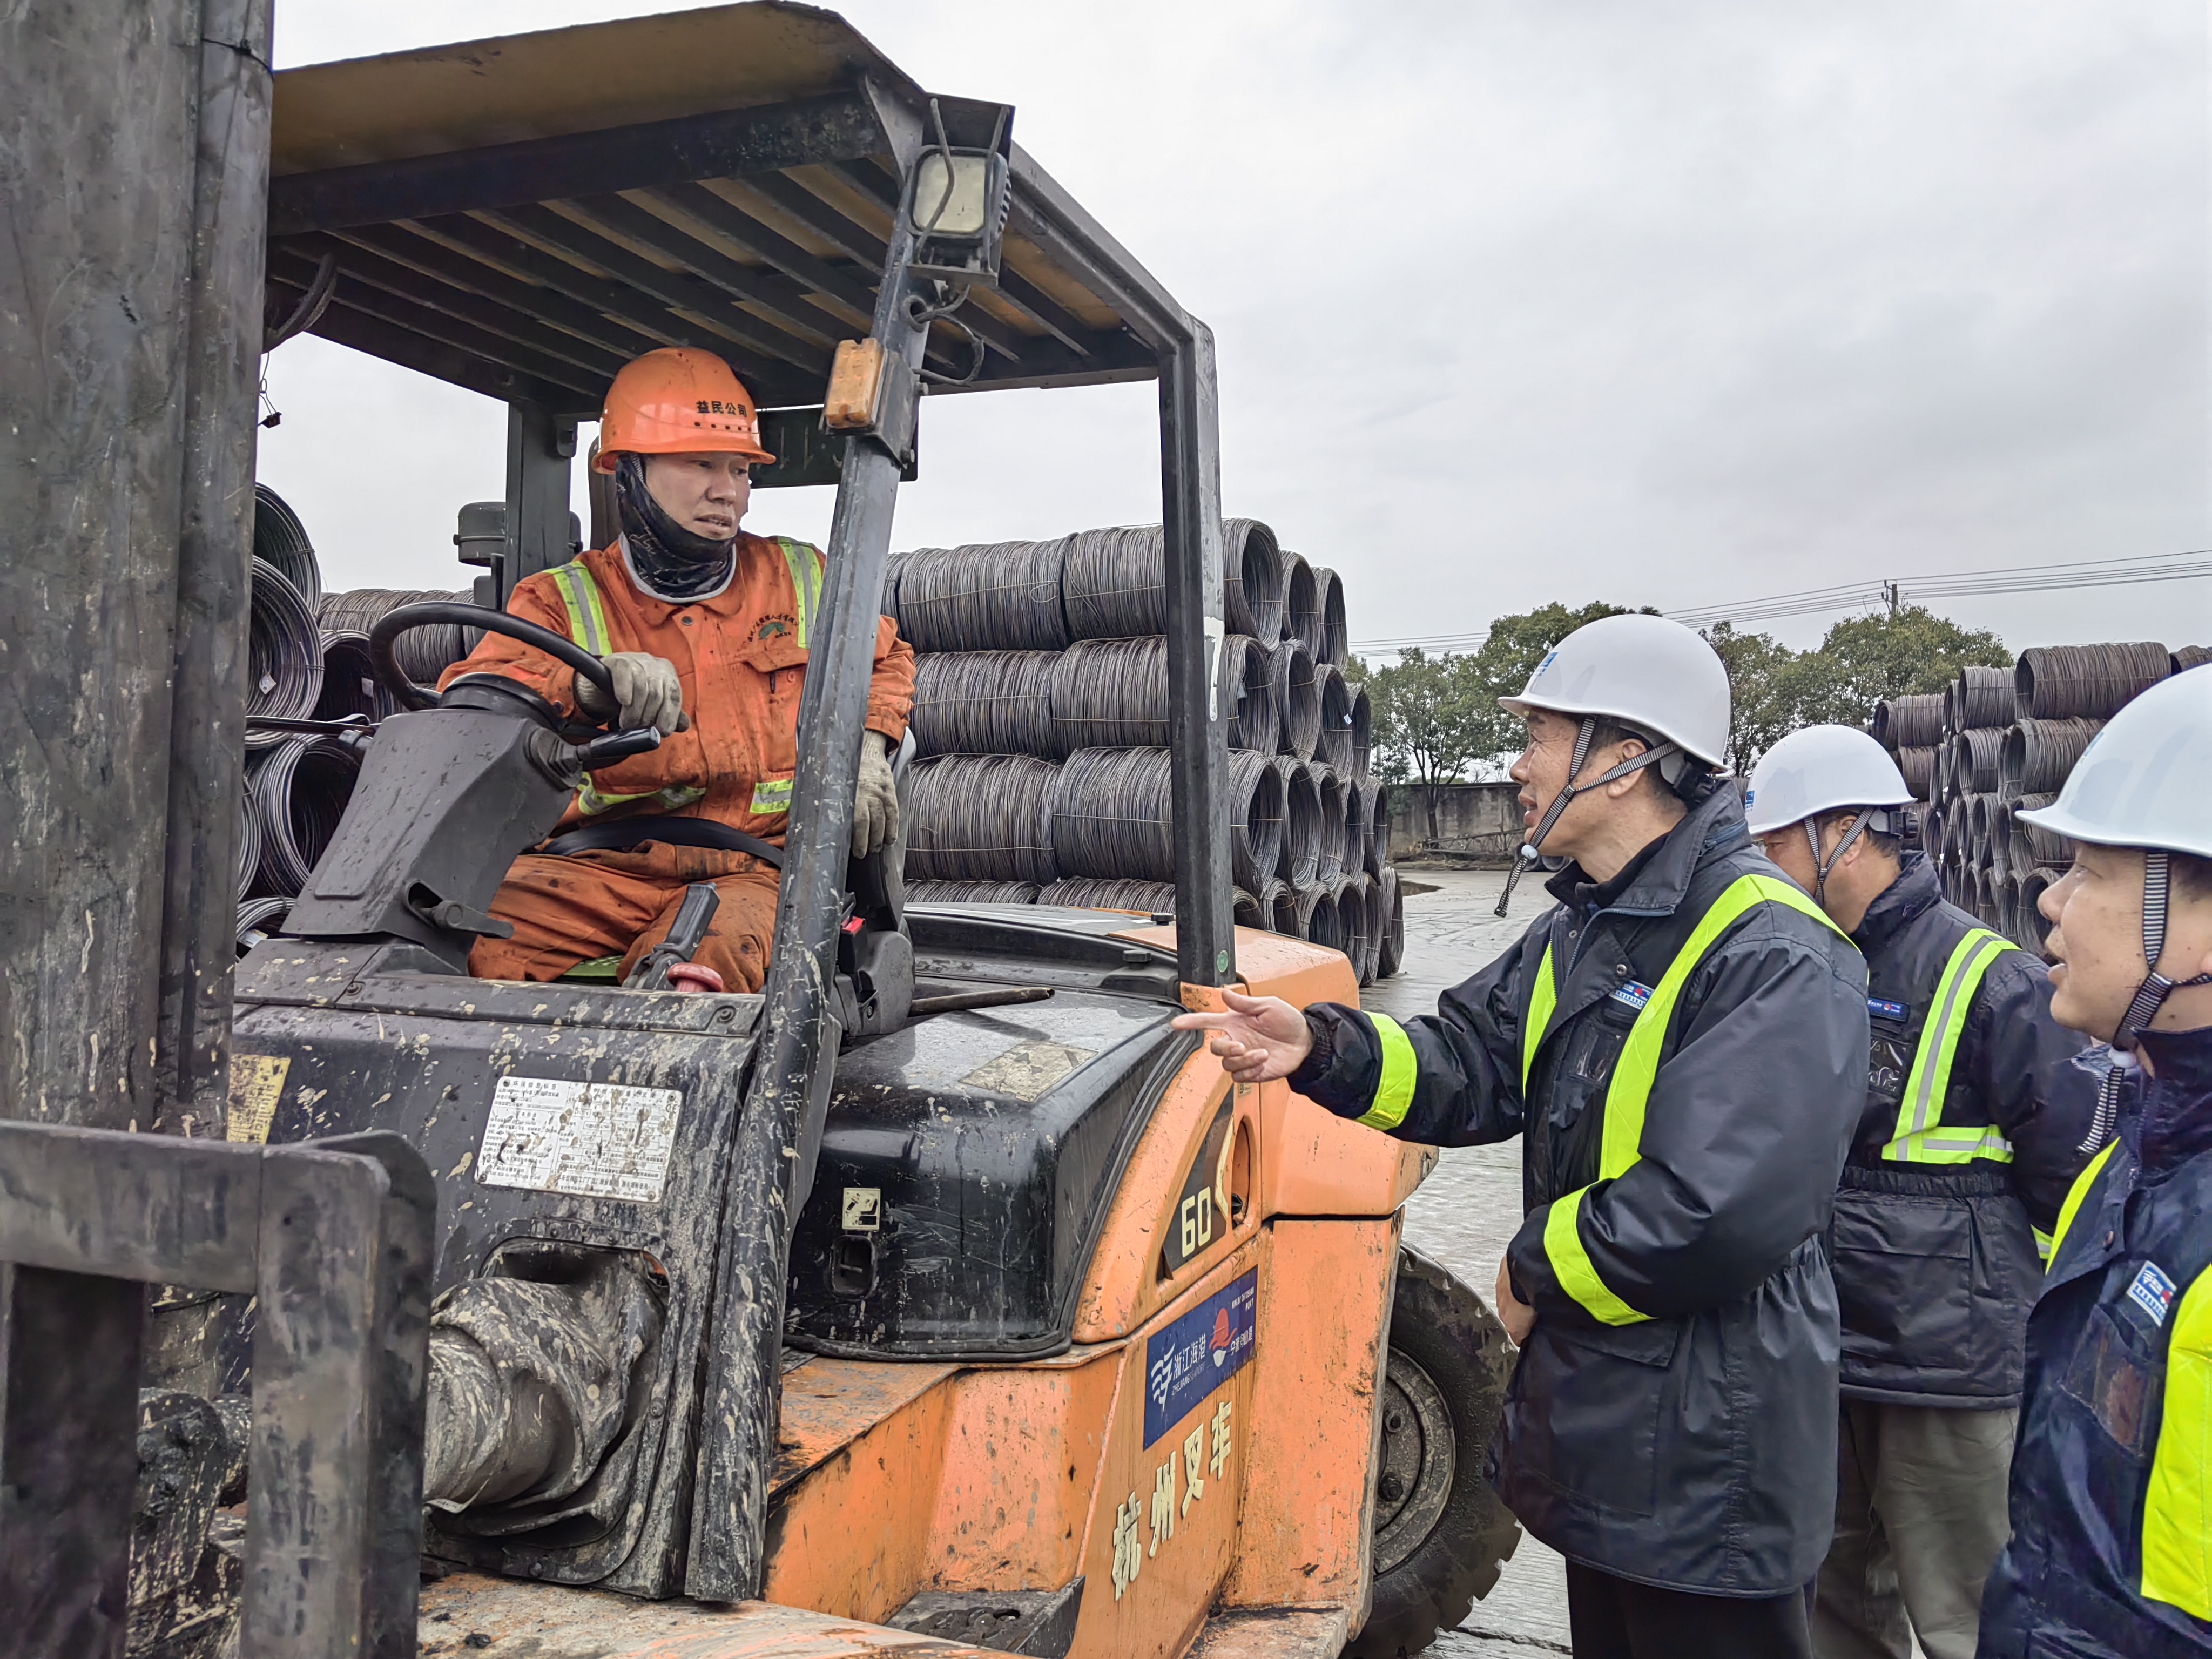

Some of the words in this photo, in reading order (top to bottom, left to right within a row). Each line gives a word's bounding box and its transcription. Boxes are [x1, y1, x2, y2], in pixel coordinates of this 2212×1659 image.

[696, 400, 747, 417] 益民公司
[1182, 1186, 1211, 1258] 60
[1173, 1333, 1206, 1381] 浙江海港
[1112, 1401, 1232, 1602] 杭州叉车
